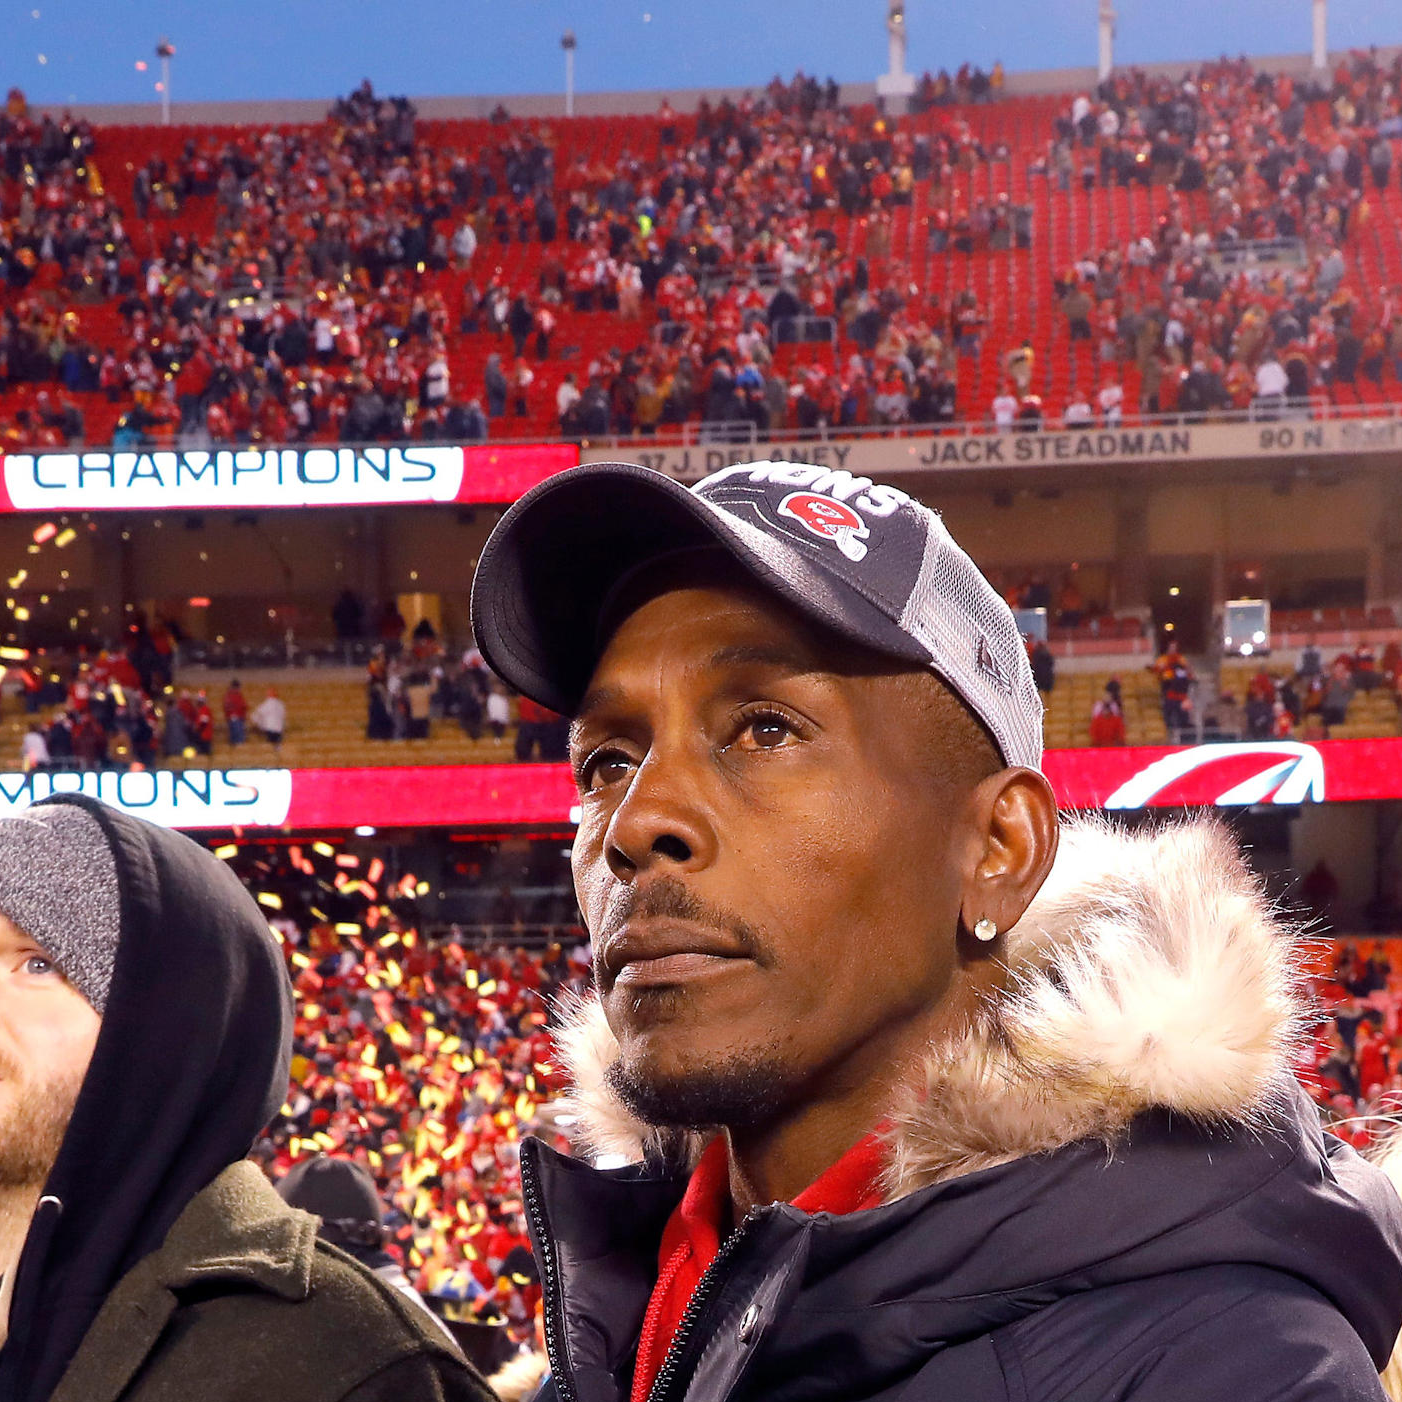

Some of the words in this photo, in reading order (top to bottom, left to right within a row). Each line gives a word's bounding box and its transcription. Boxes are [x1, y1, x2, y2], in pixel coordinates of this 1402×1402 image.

[920, 438, 1005, 465] JACK
[1015, 431, 1190, 461] STEADMAN
[1258, 427, 1295, 449] 90
[33, 448, 437, 488] CHAMPIONS
